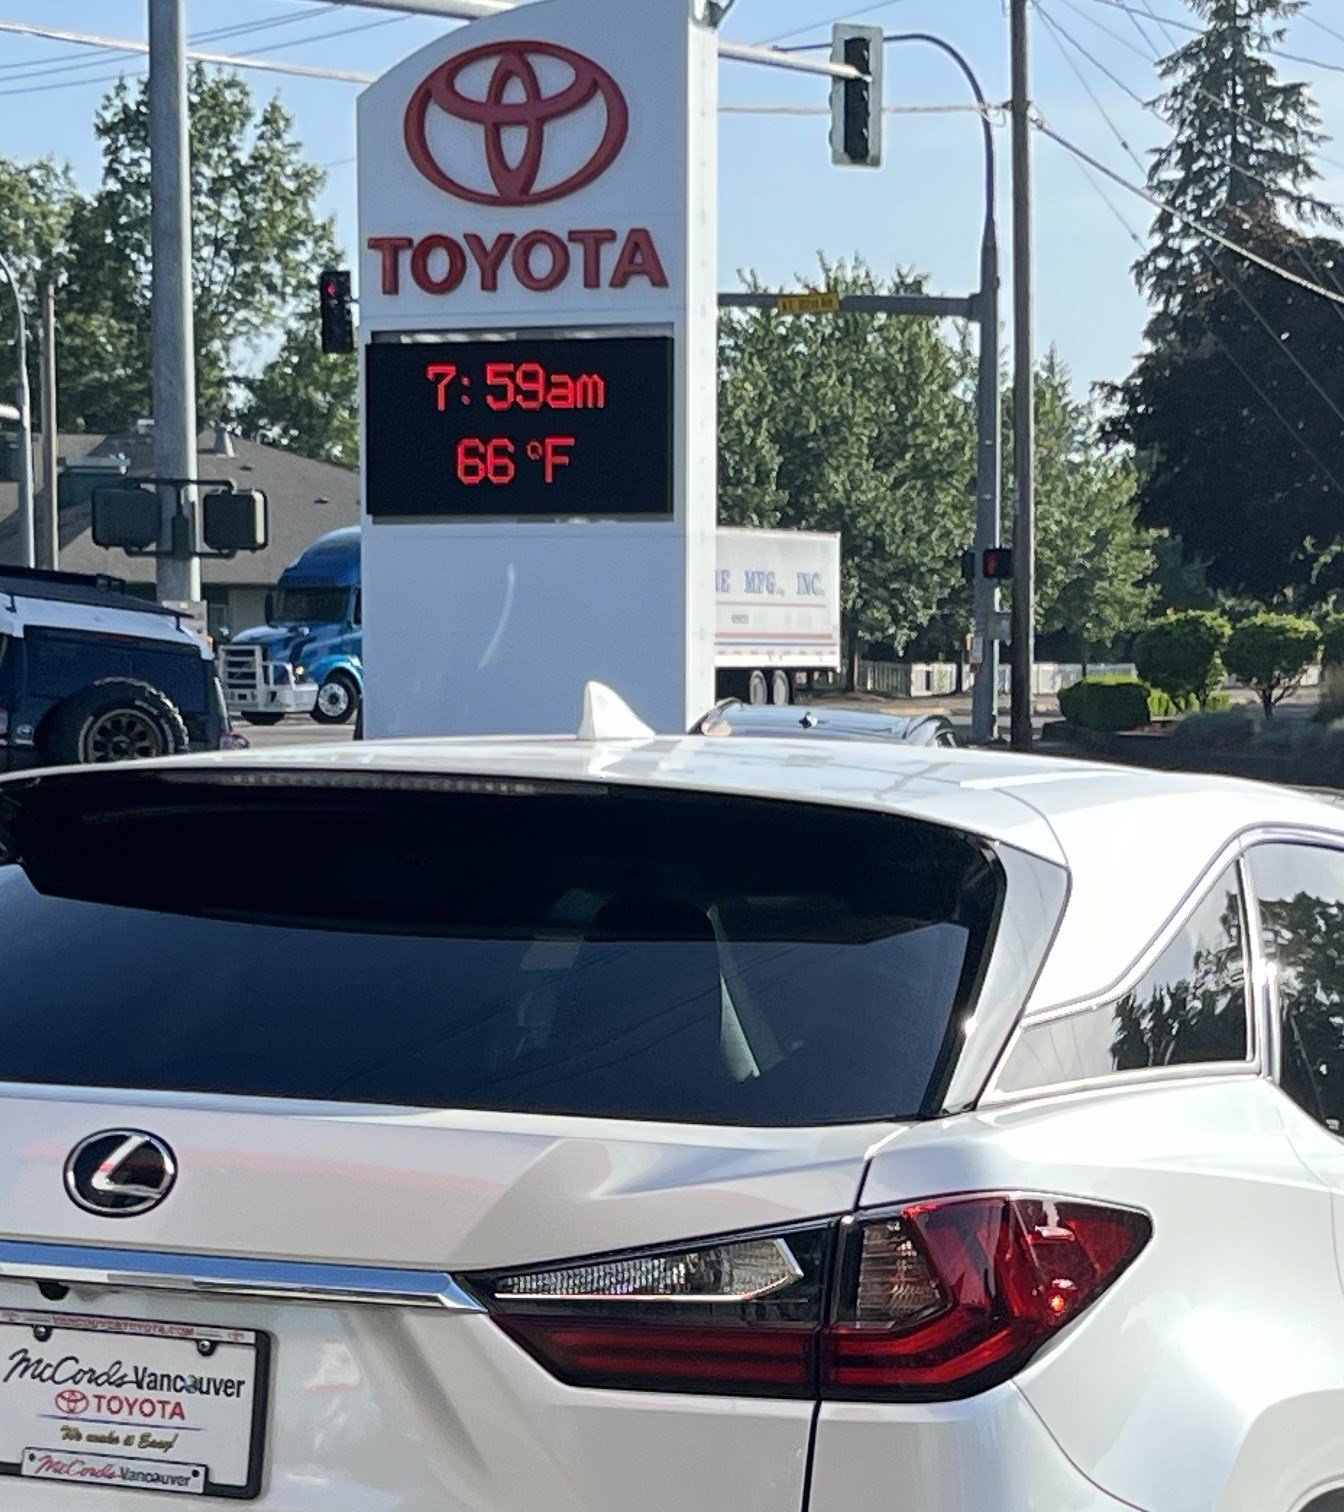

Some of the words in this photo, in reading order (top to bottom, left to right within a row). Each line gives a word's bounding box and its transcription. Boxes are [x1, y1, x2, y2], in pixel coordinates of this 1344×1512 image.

[367, 227, 669, 296] TOYOTA
[425, 362, 606, 411] 7:59am
[133, 1365, 245, 1398] Vancouver
[92, 1394, 186, 1421] TOYOTA
